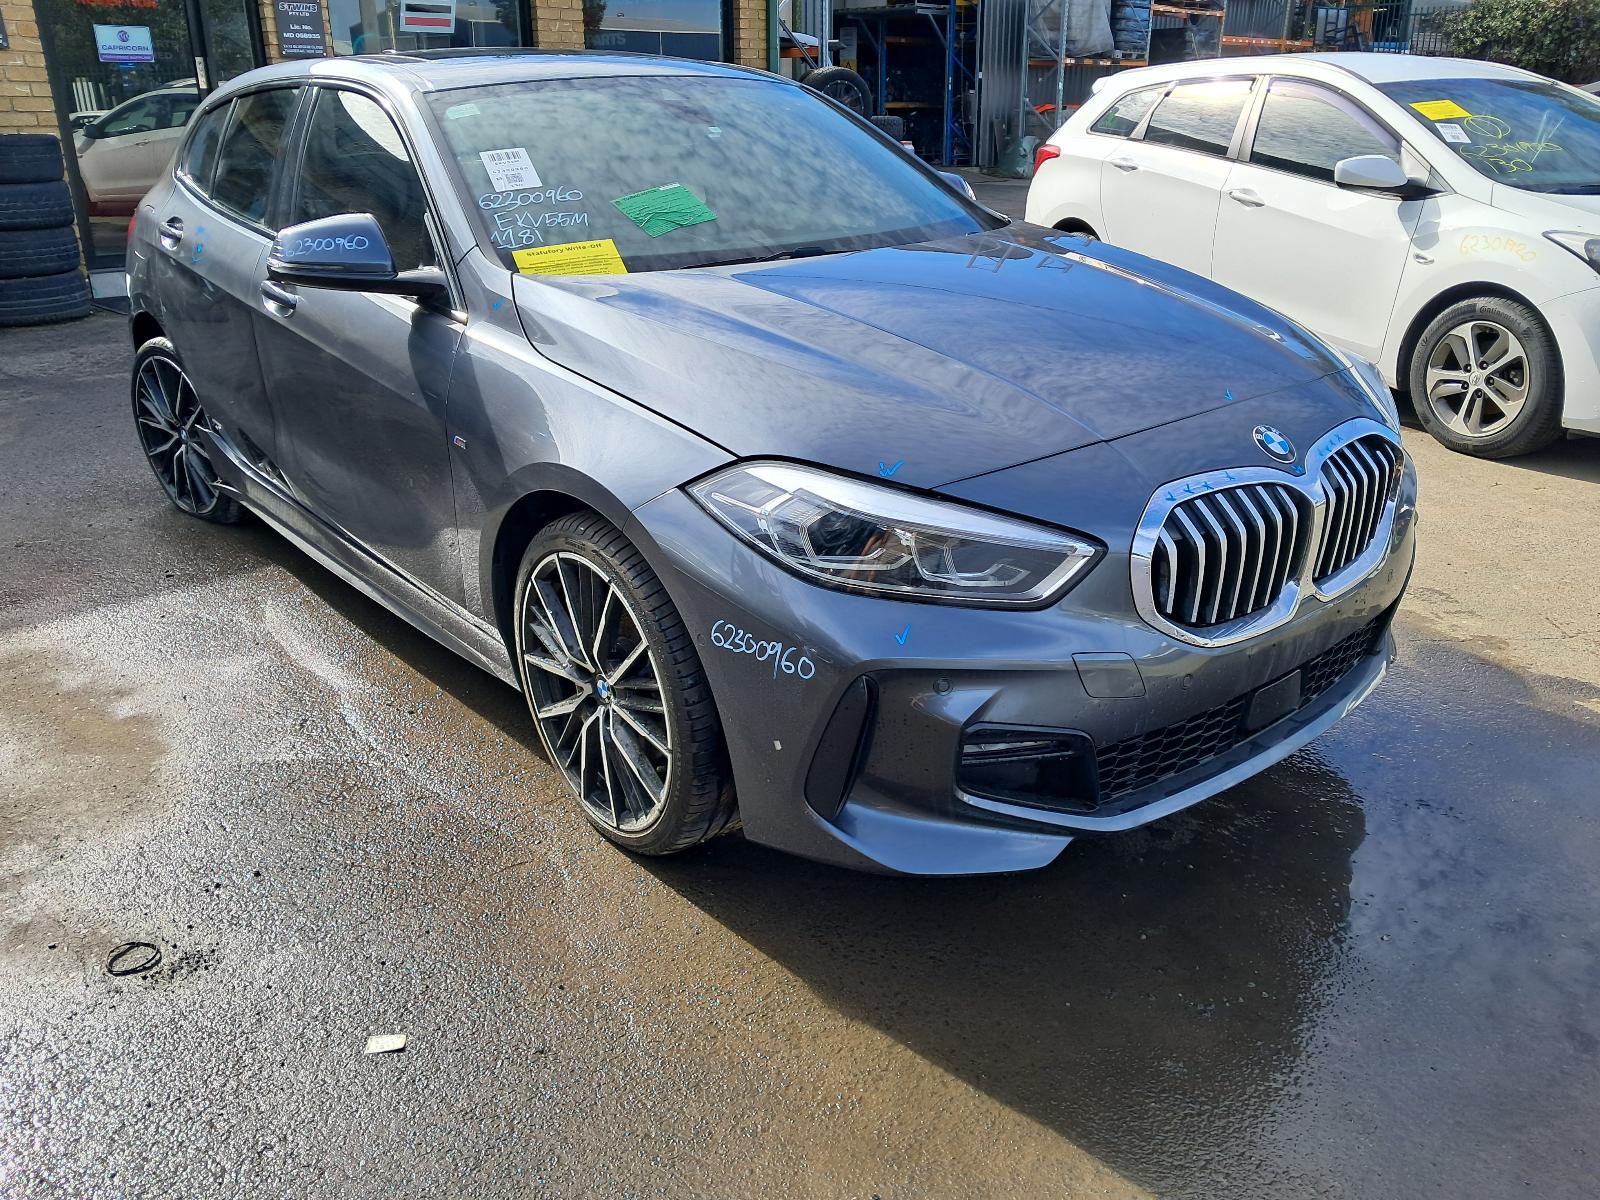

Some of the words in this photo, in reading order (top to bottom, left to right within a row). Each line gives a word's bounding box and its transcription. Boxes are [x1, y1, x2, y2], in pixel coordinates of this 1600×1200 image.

[102, 44, 149, 52] CAPRICORN
[479, 186, 583, 211] 62300960
[493, 211, 589, 231] EKV55M
[285, 234, 369, 257] 62300960
[526, 248, 564, 258] Statutory
[710, 619, 816, 680] 62300960
